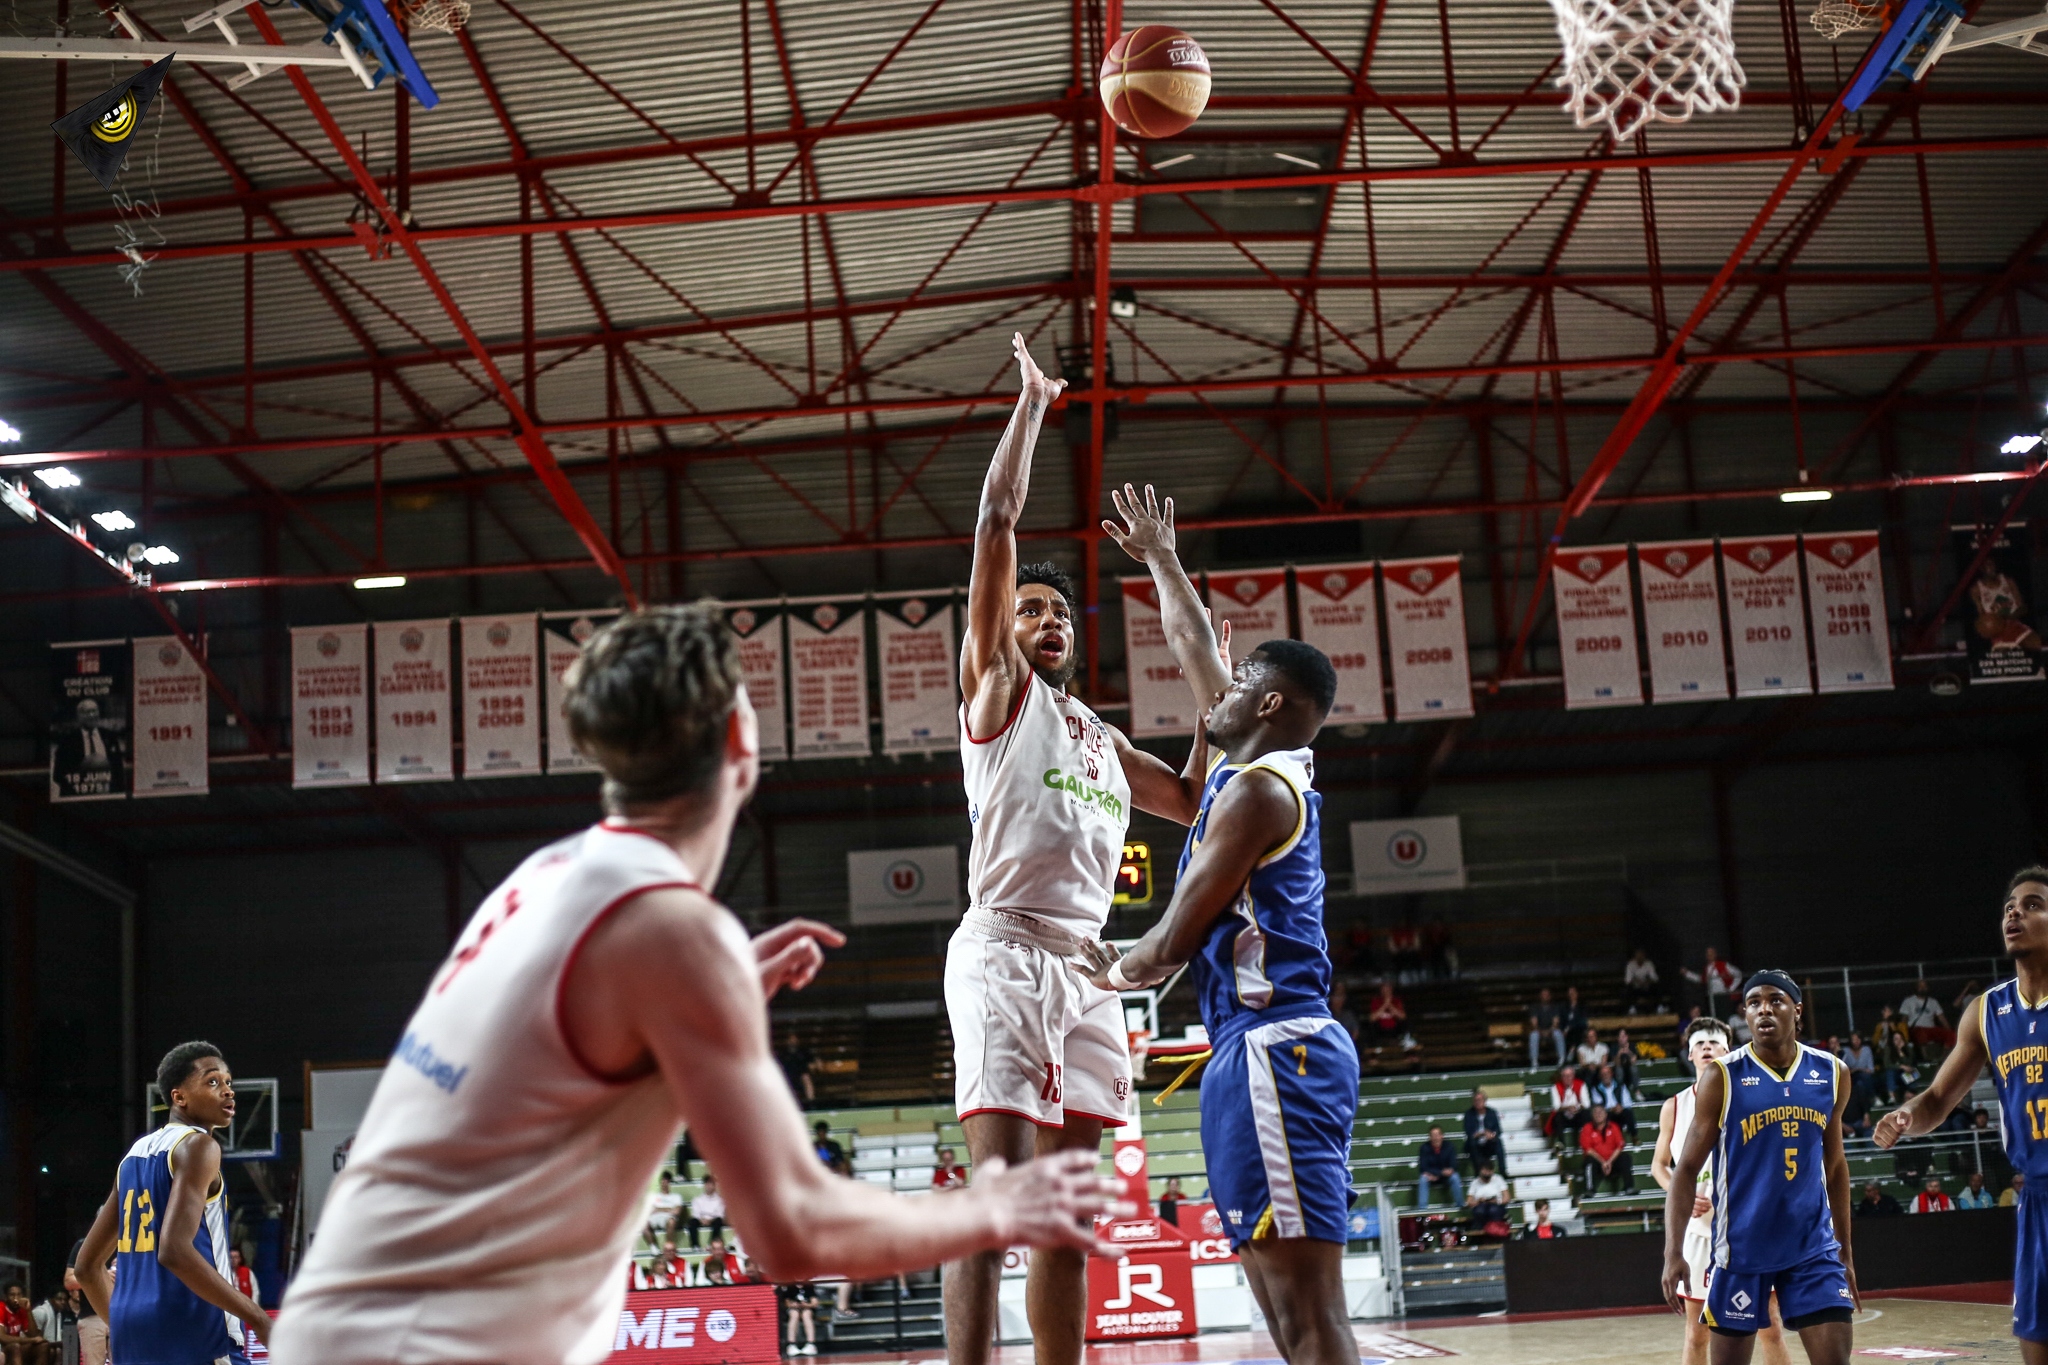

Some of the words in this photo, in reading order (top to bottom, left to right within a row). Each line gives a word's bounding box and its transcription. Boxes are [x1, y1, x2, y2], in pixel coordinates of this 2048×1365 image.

[1731, 576, 1795, 588] CHAMPION
[1825, 582, 1853, 593] PRO
[1857, 582, 1866, 592] A
[1748, 587, 1795, 598] FRANCE
[1745, 597, 1773, 609] PRO
[1827, 604, 1871, 619] 1988
[1745, 626, 1792, 643] 2010
[1827, 620, 1872, 636] 2011
[1662, 630, 1709, 648] 2010
[154, 684, 201, 695] FRANCE
[391, 709, 437, 727] 1994
[150, 725, 193, 741] 1991
[1043, 768, 1122, 823] GAUTIER
[1292, 1044, 1307, 1076] 7
[2025, 1063, 2044, 1084] 92
[1040, 1061, 1062, 1104] 13
[1740, 1105, 1828, 1146] METROPOLITANS
[1781, 1121, 1800, 1138] 92
[1784, 1147, 1798, 1181] 5
[117, 1188, 155, 1253] 12
[1095, 1313, 1130, 1329] JEAN
[1130, 1310, 1184, 1325] ROUYER
[1101, 1322, 1180, 1336] AUTOMOBILES
